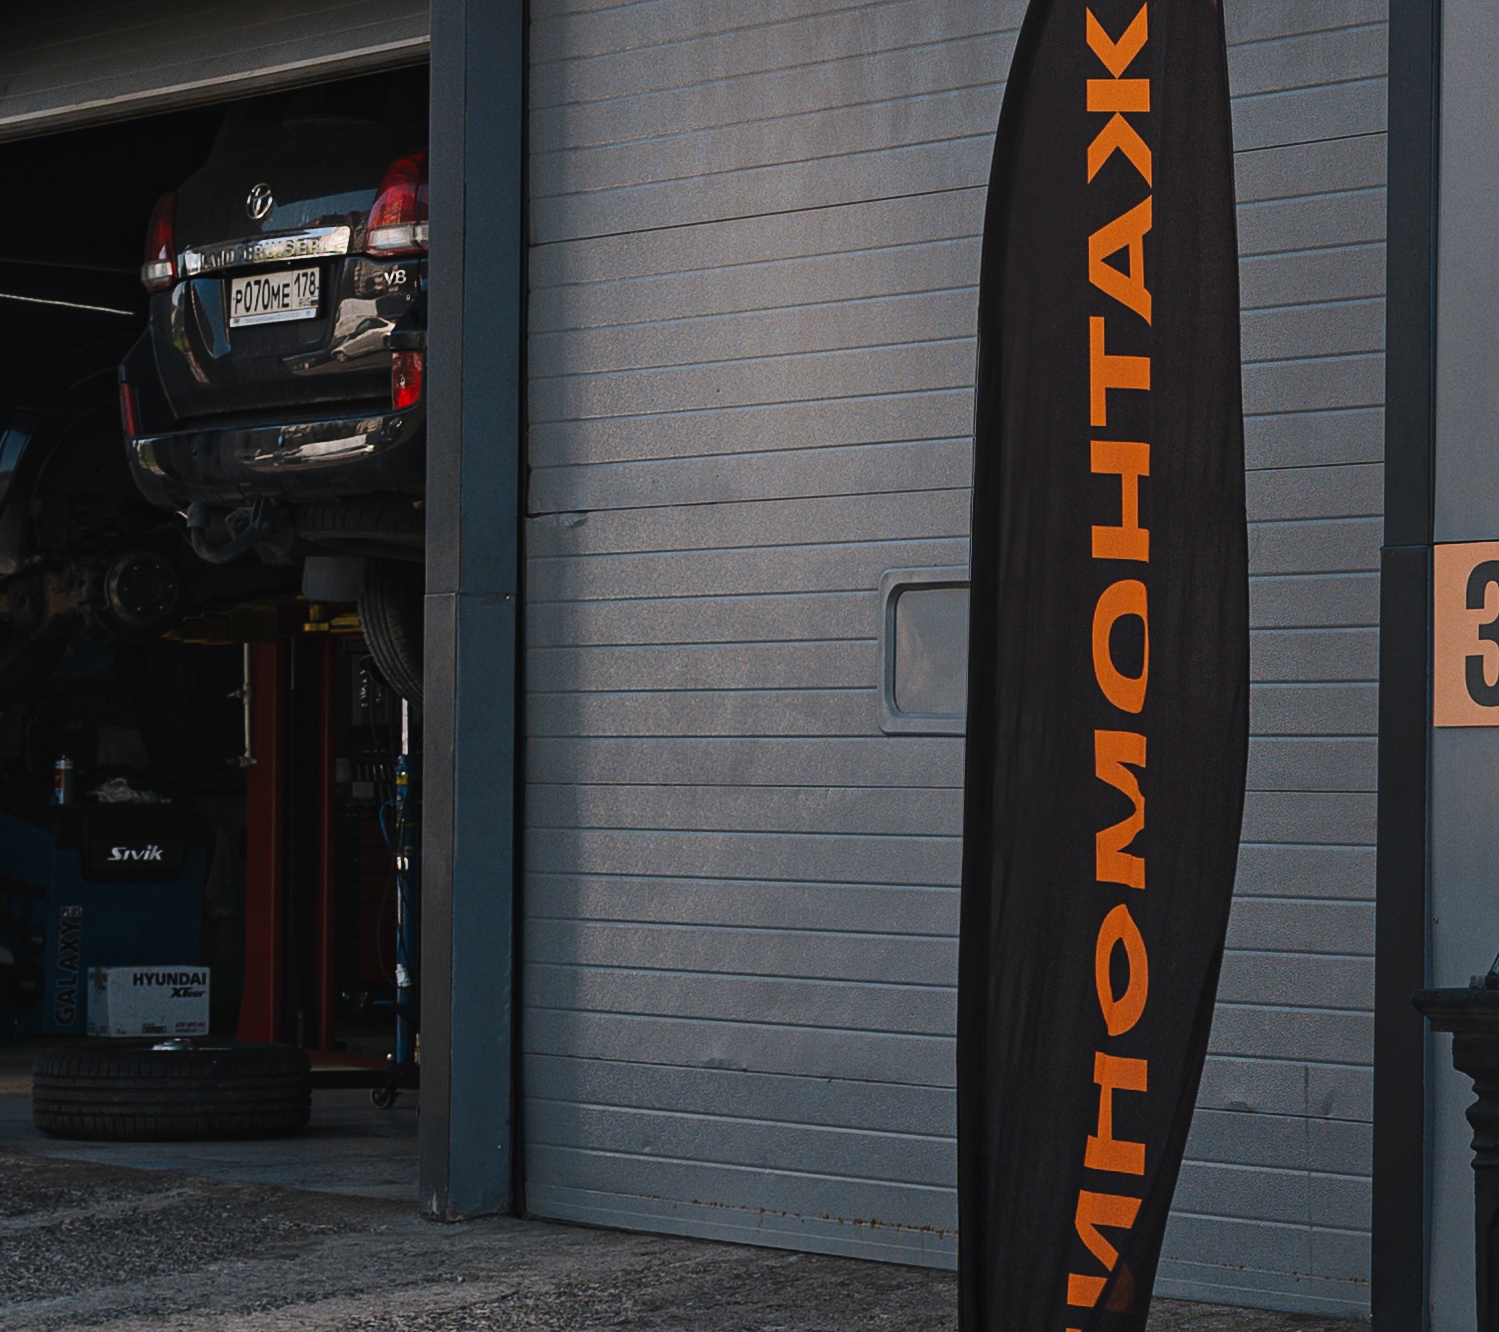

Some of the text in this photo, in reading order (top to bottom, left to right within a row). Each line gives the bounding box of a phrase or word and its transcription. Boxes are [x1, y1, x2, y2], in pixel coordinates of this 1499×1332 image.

[293, 271, 316, 297] 178
[384, 269, 407, 285] V8
[54, 920, 82, 1026] GALAXY
[132, 972, 207, 987] HYUNDAI
